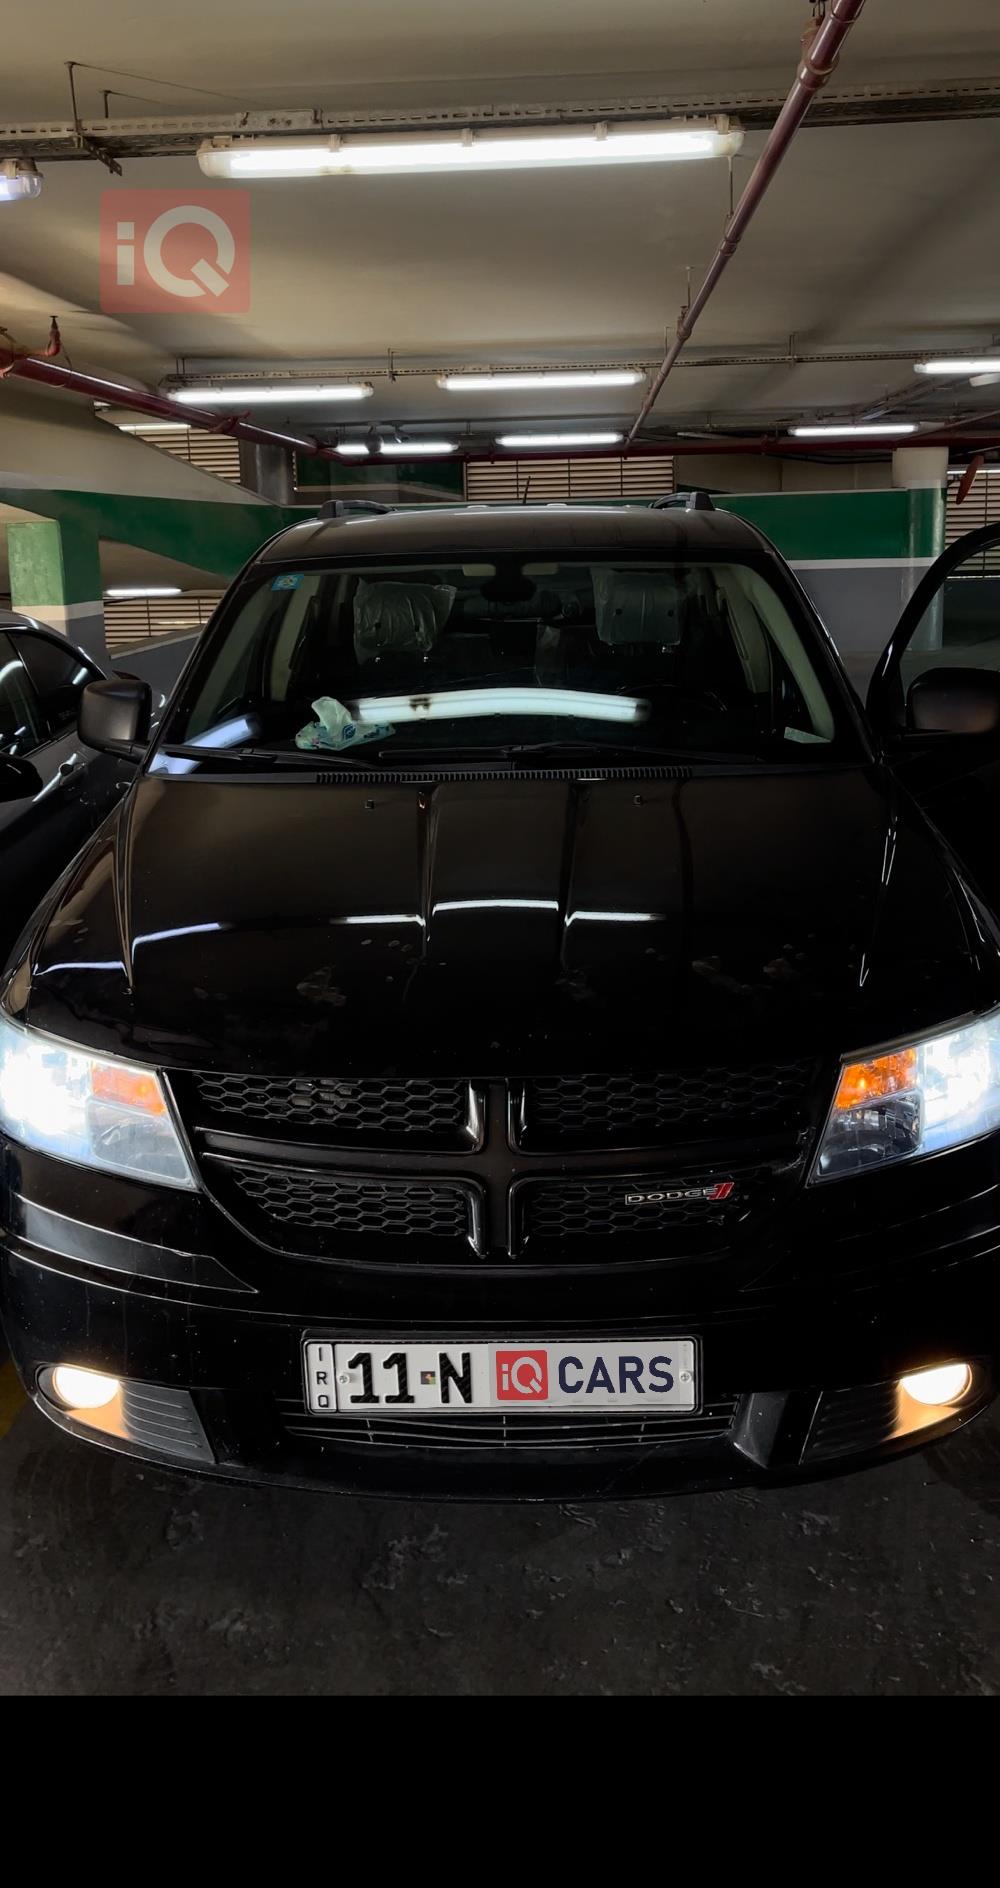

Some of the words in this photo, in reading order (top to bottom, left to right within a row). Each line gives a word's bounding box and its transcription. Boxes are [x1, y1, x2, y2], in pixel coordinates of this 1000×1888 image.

[627, 1187, 718, 1203] DODGE
[347, 1352, 415, 1404] 11
[438, 1352, 473, 1404] N
